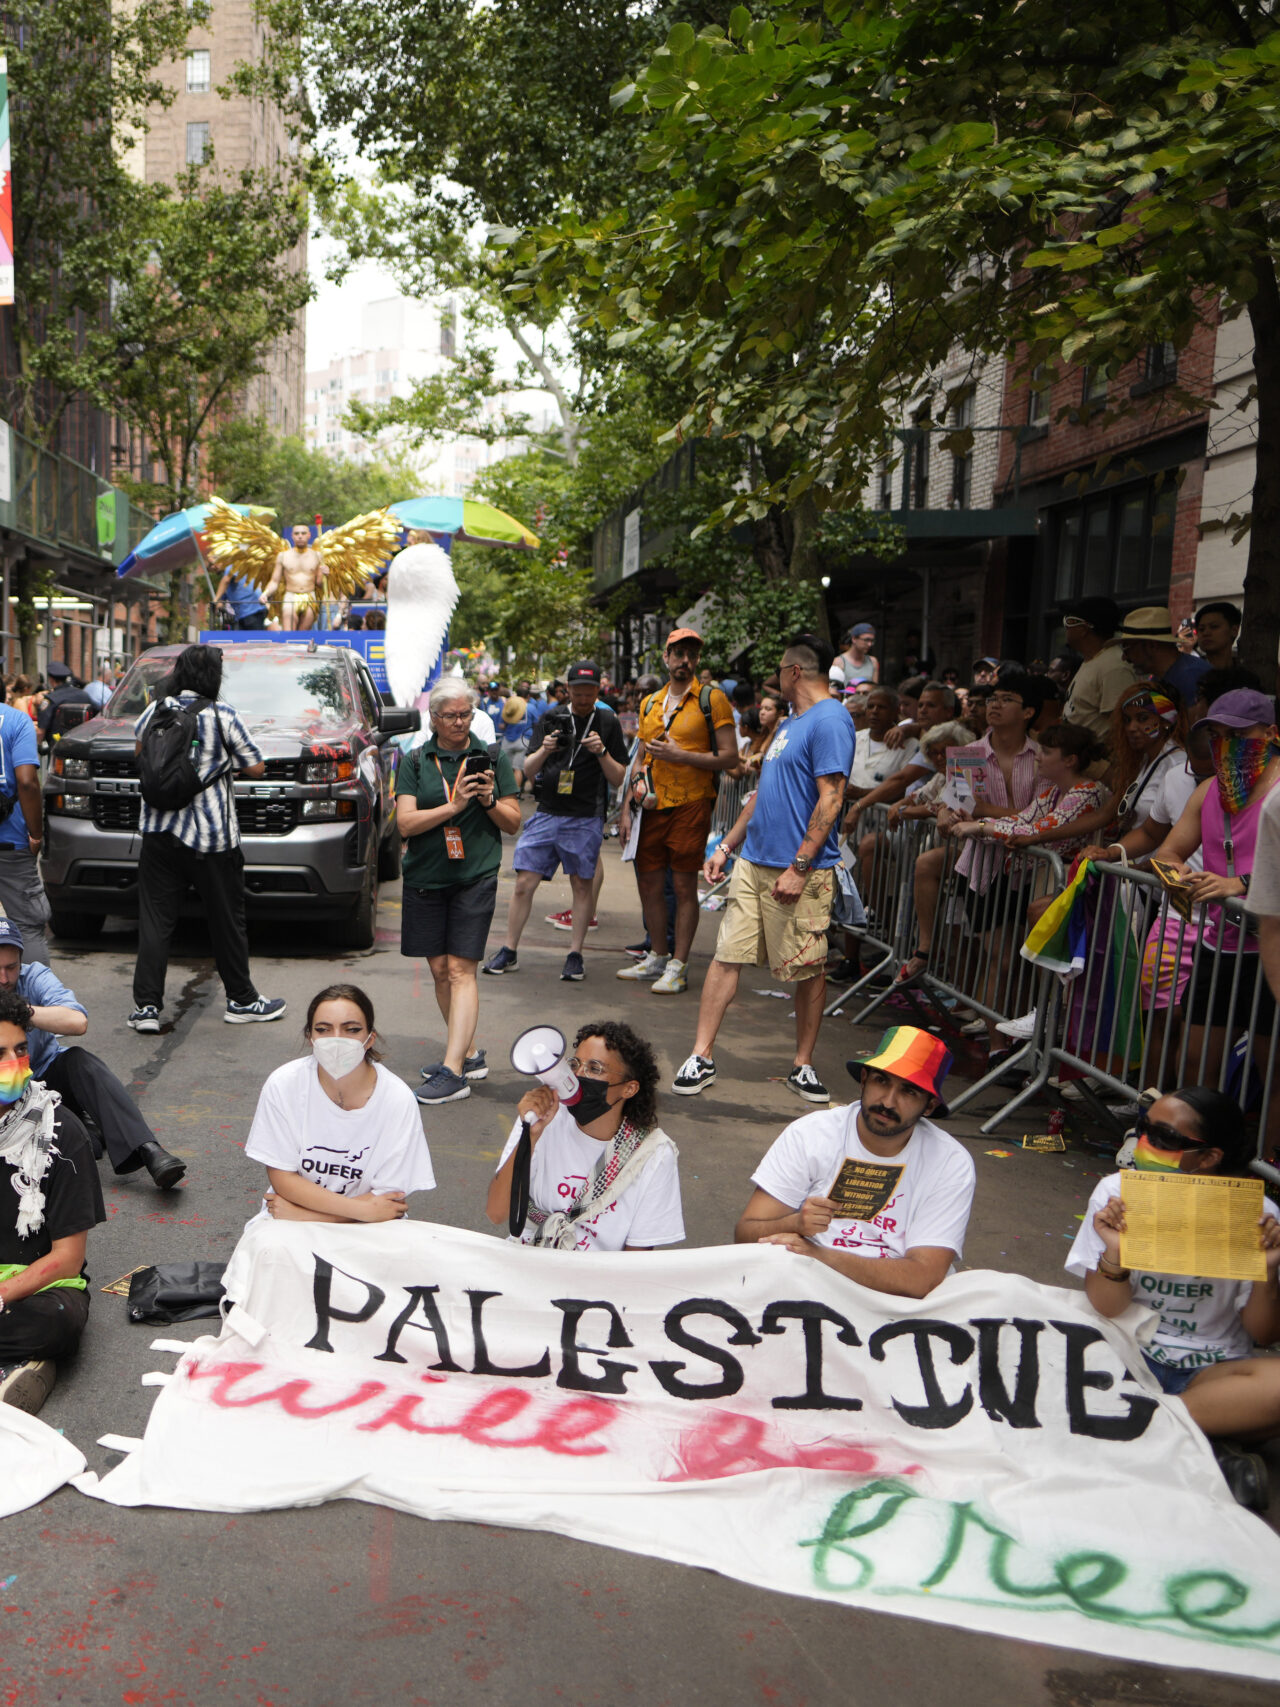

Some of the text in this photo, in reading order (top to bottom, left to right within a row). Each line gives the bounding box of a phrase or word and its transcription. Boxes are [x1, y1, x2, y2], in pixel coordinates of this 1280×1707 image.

[301, 1158, 364, 1180] QUEER
[854, 1166, 889, 1177] NO QUEER
[845, 1178, 886, 1190] LIBERATION
[843, 1190, 876, 1201] WITHOUT
[1140, 1275, 1214, 1298] QUEER
[304, 1252, 1160, 1442] PALESTINE
[1144, 1346, 1227, 1369] ESTINE
